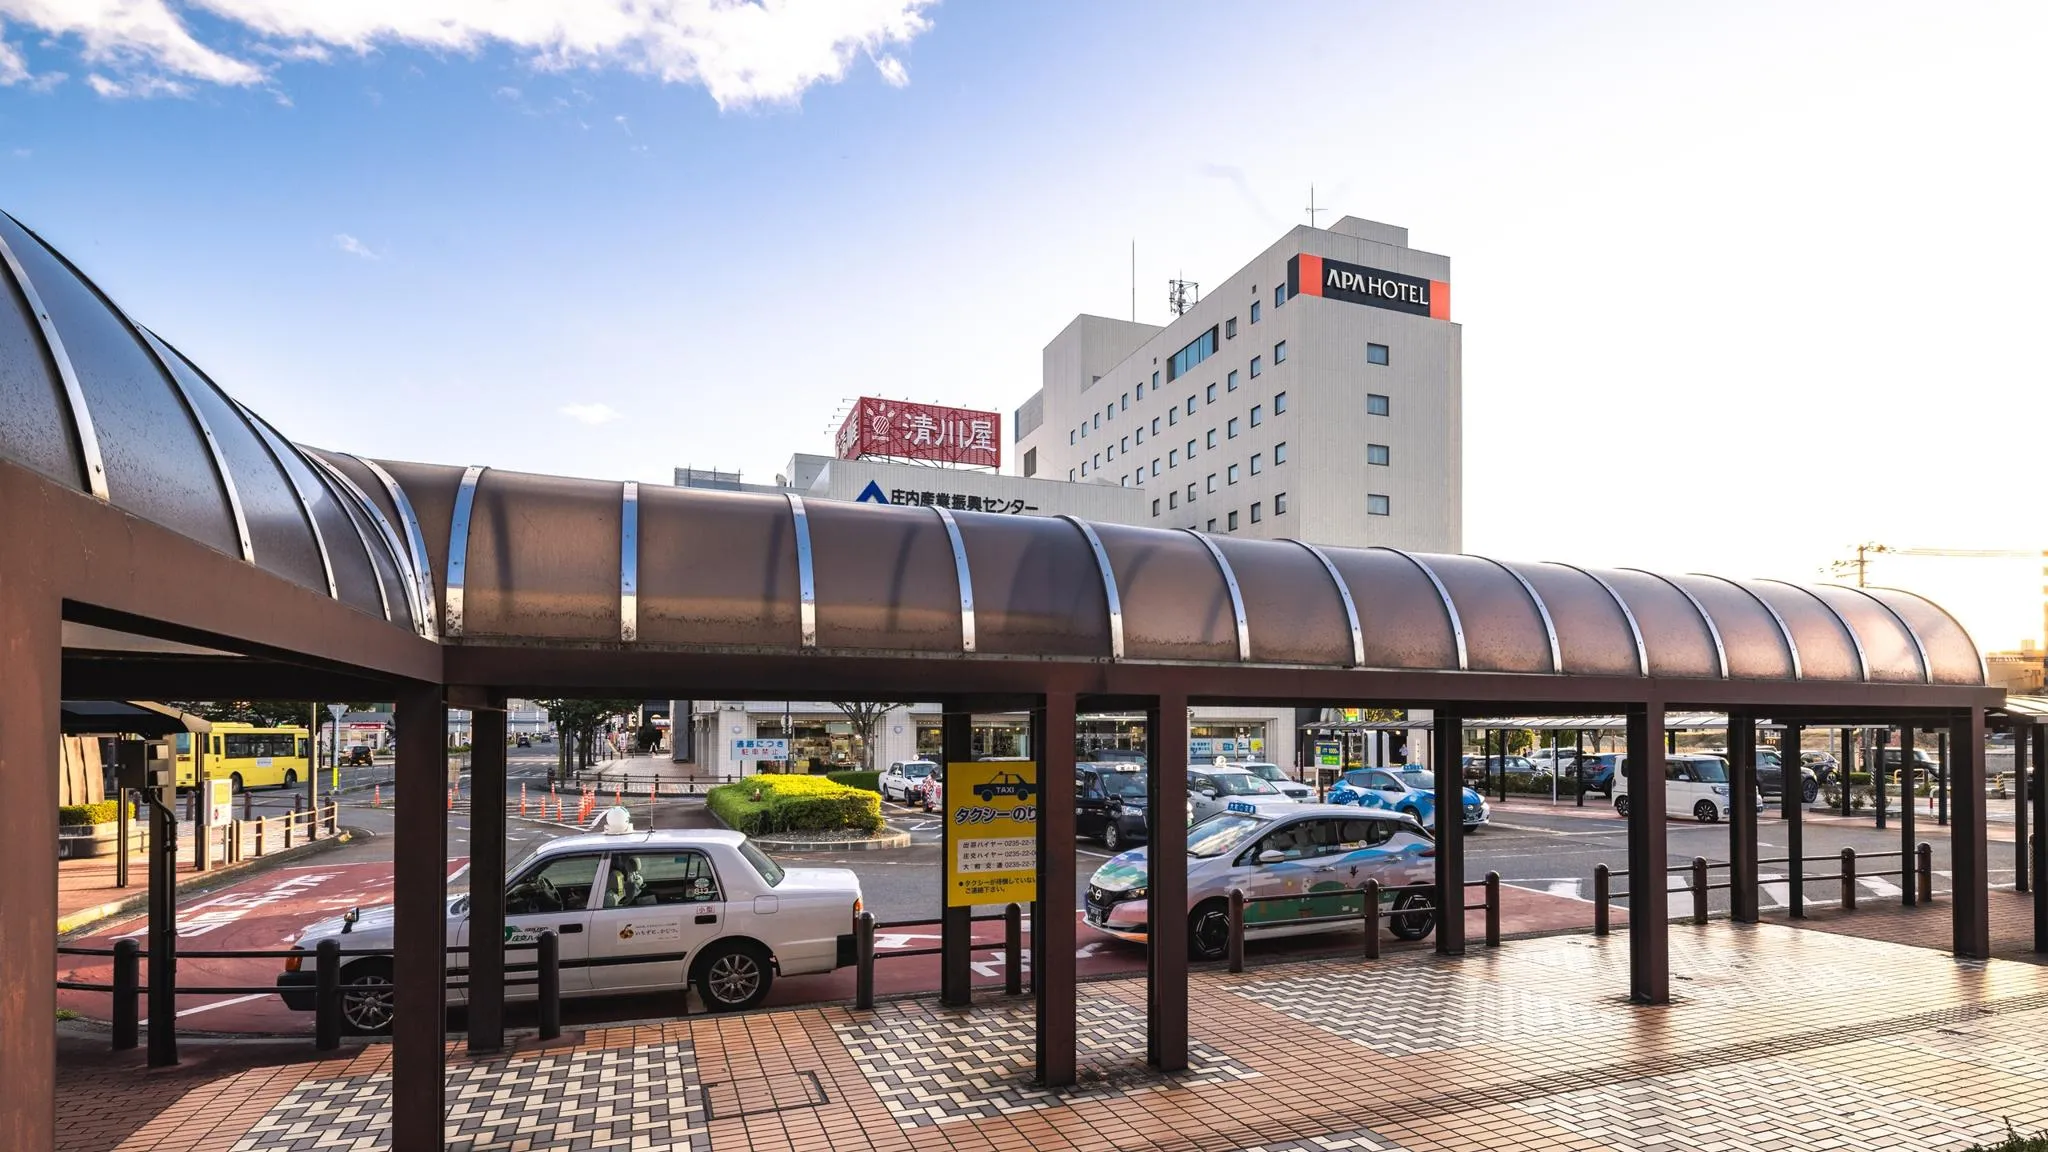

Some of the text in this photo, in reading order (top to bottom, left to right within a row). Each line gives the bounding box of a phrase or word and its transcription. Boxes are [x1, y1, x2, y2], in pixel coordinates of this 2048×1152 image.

[1327, 268, 1429, 305] APA HOTEL
[902, 413, 997, 453] 清川屋
[890, 489, 1039, 514] 庄内産業振興センター
[996, 786, 1015, 794] TAXI
[1004, 839, 1037, 848] 0235-22-1
